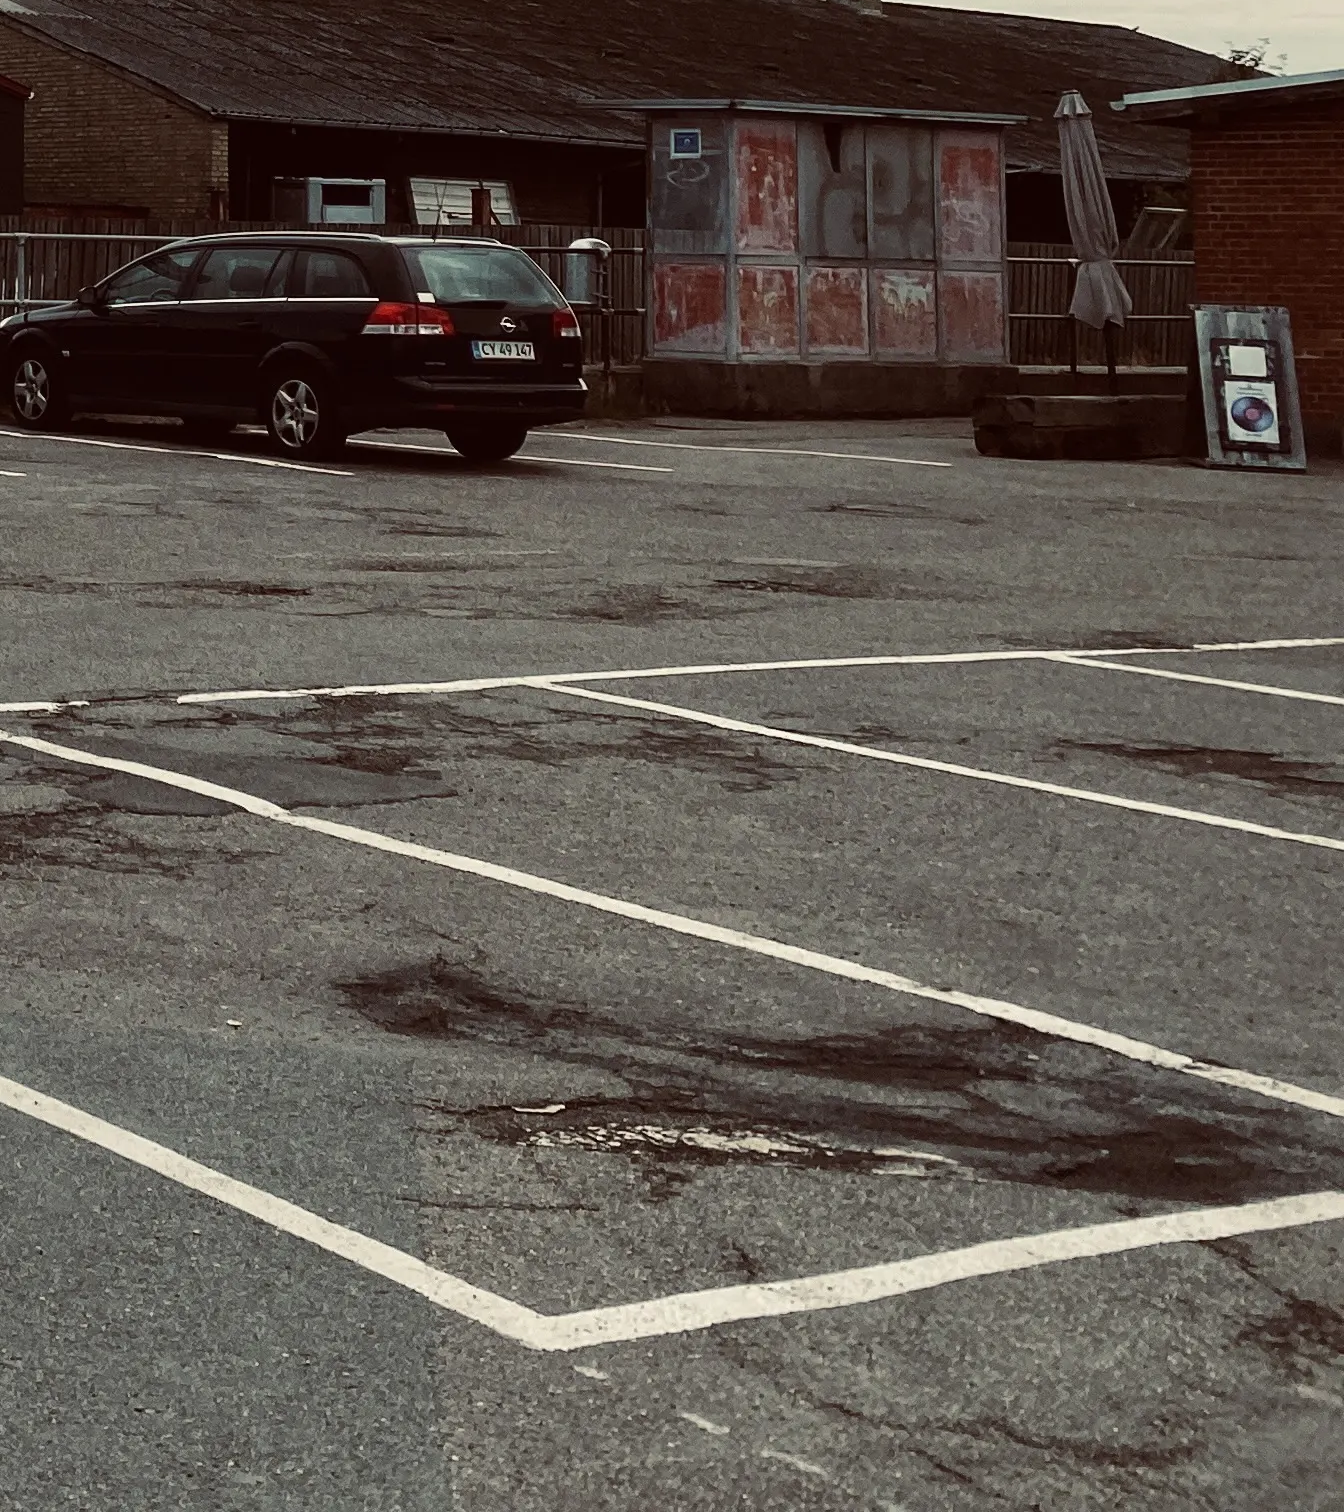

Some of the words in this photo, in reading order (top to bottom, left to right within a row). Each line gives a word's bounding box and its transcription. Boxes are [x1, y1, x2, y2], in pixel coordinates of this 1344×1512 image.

[481, 342, 496, 356] CY
[499, 343, 512, 356] 49
[514, 343, 532, 357] 147
